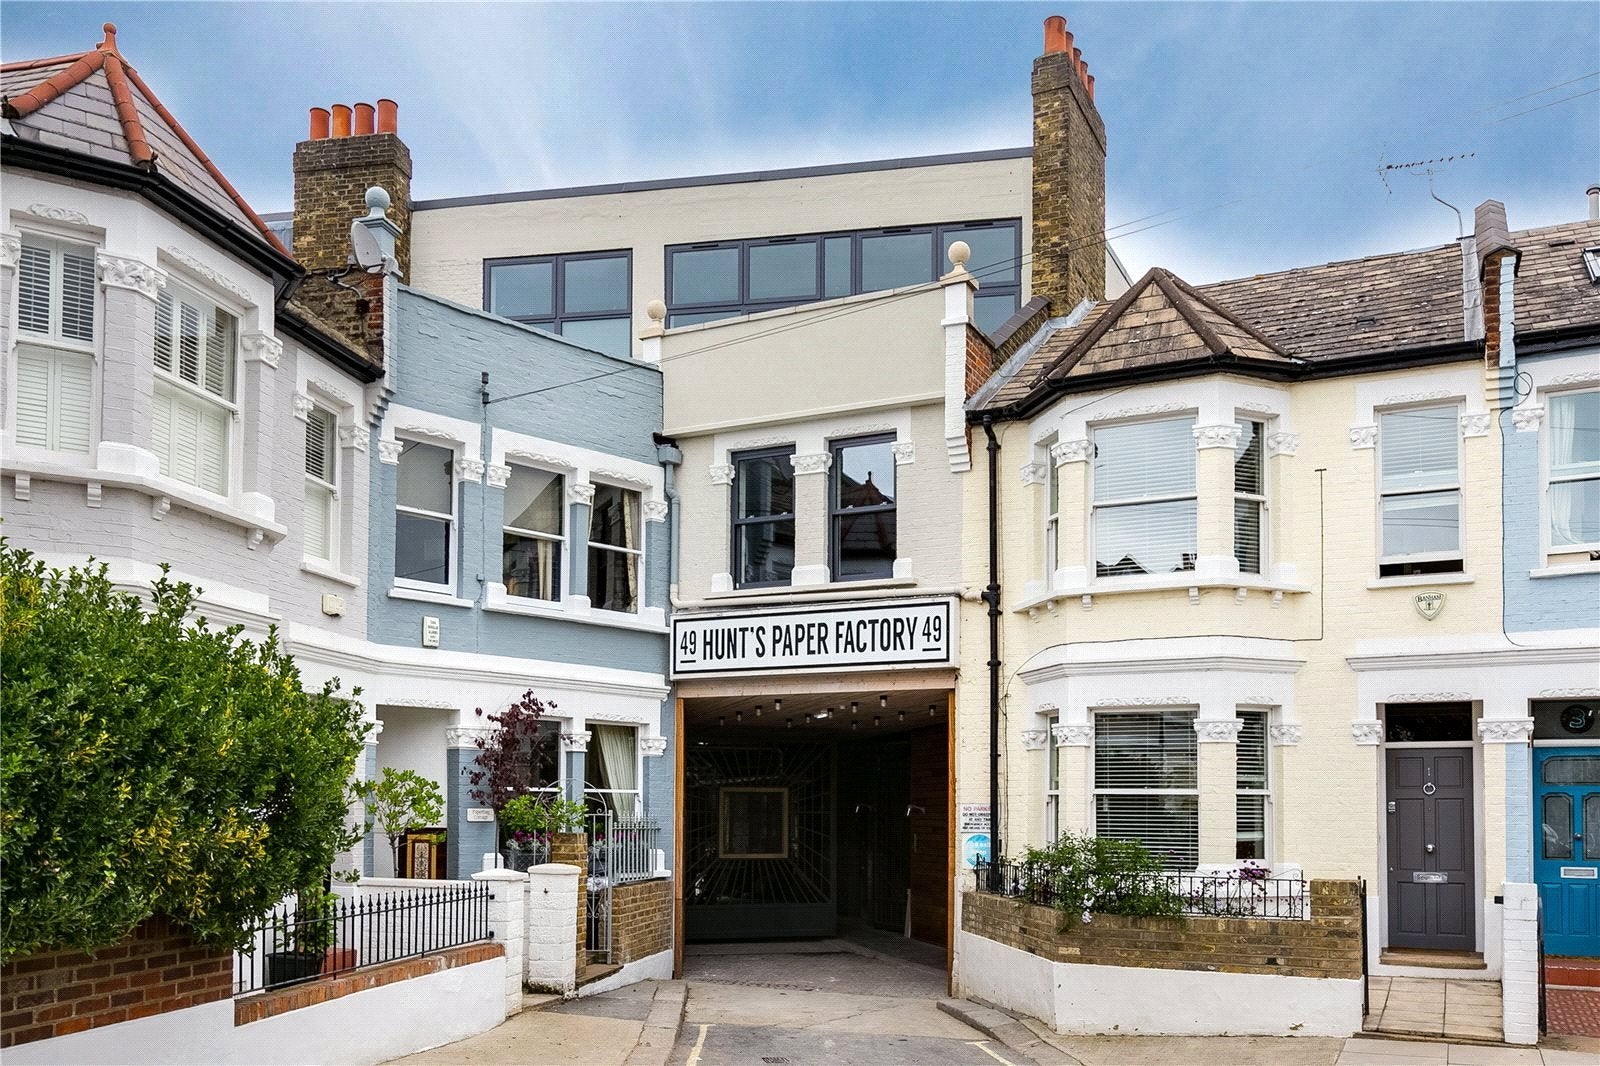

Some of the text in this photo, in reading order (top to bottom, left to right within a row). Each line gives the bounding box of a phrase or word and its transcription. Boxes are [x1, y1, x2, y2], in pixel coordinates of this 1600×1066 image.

[680, 615, 942, 660] 49 HUNT'S PAPER FACTORY 49
